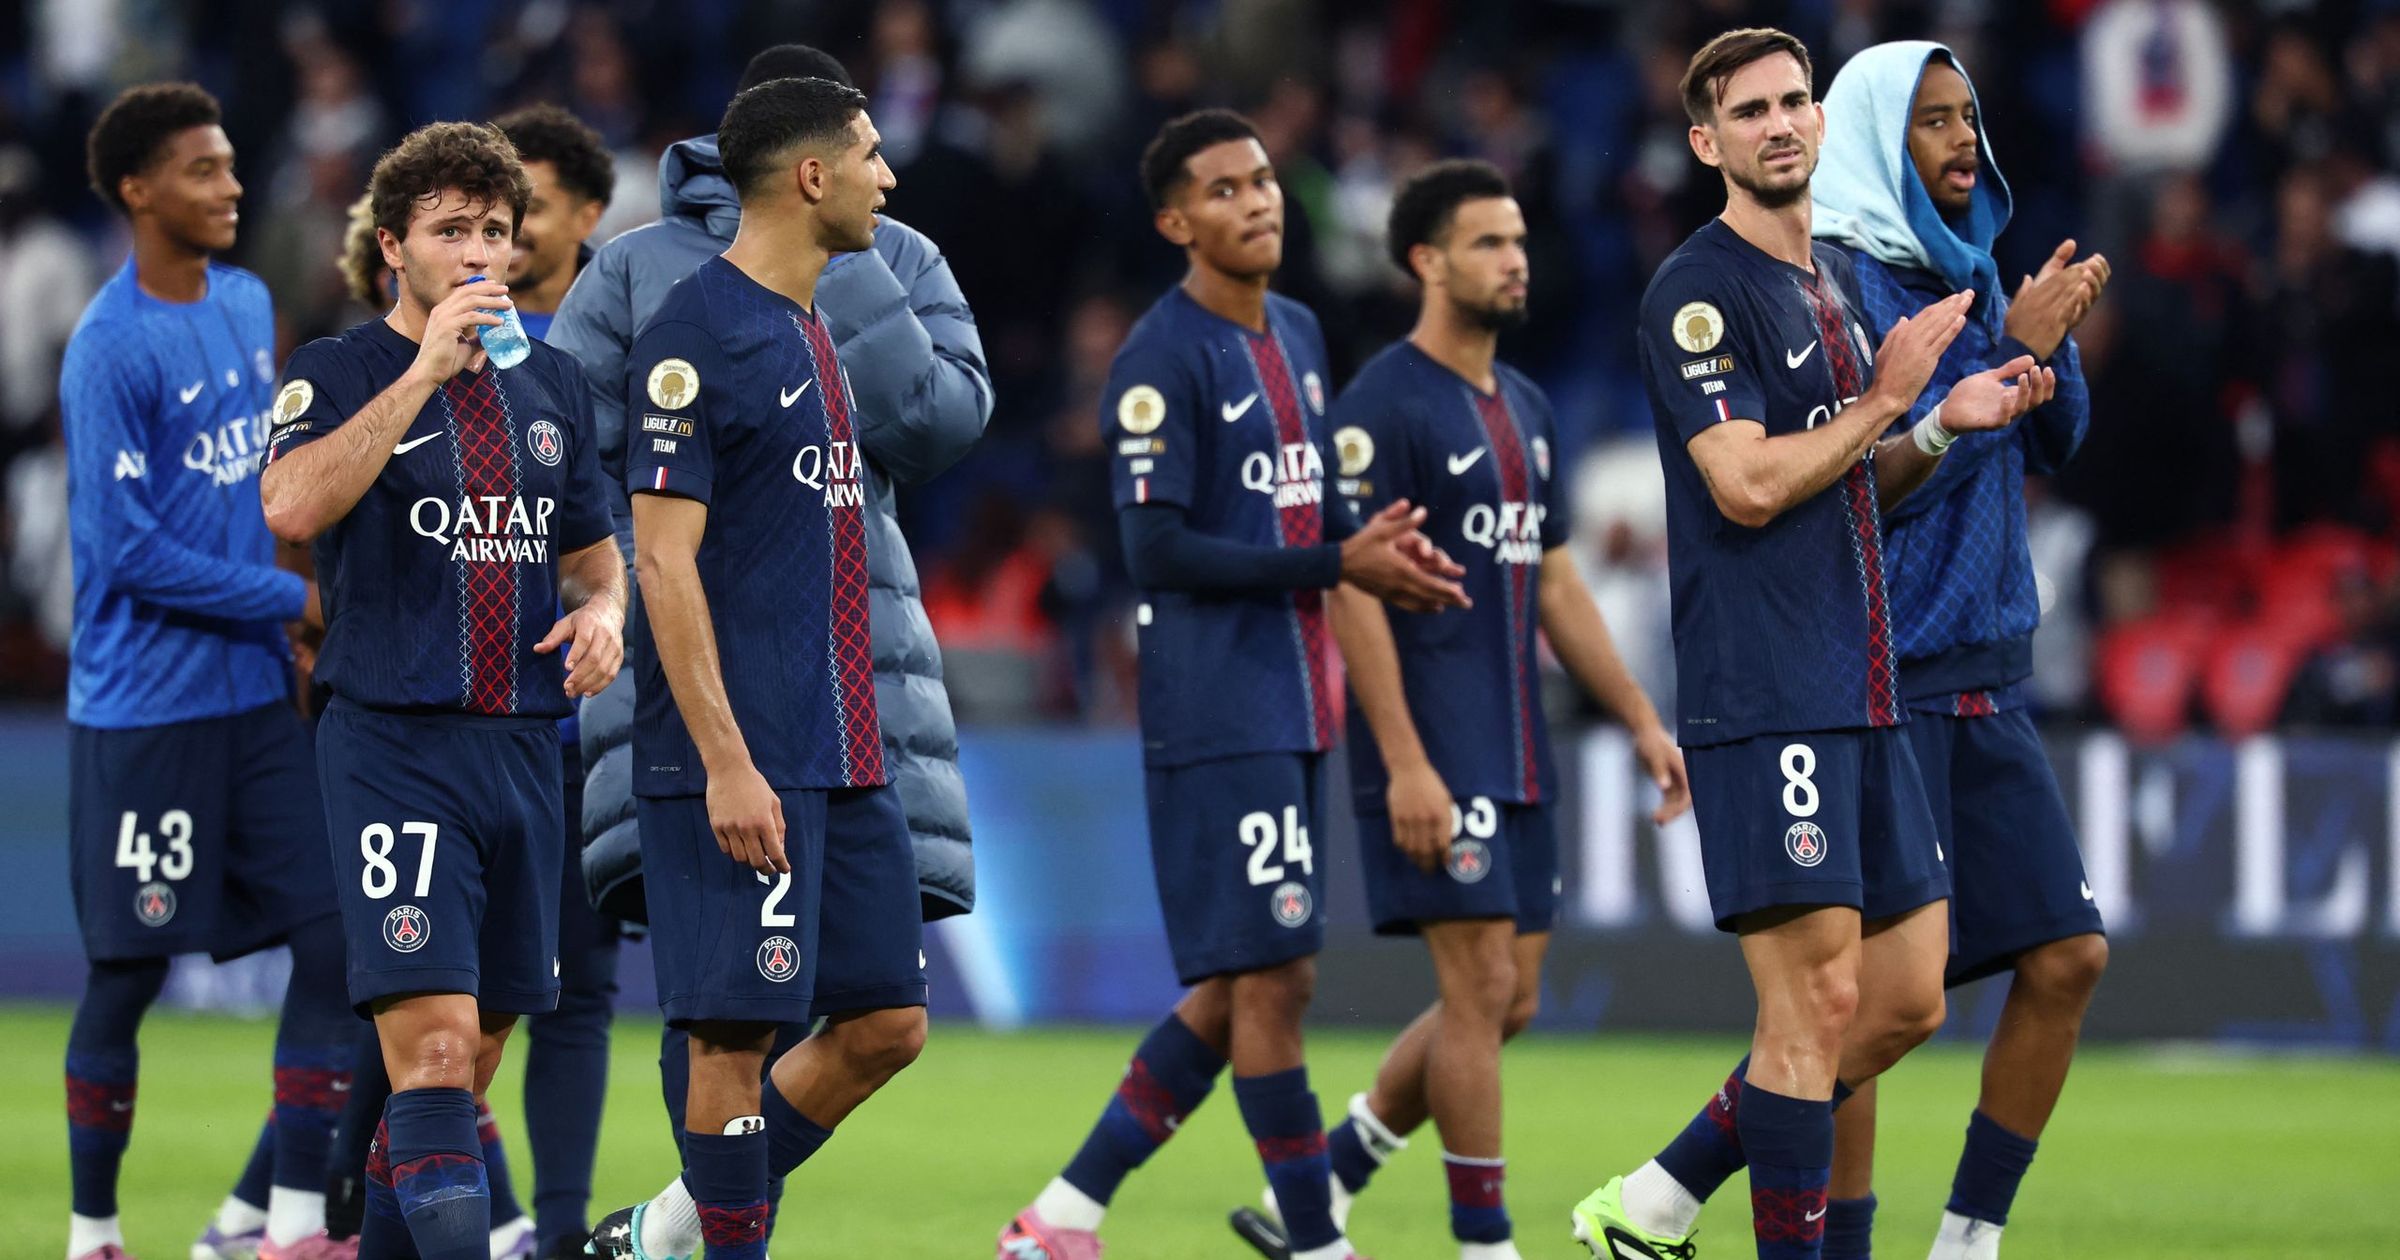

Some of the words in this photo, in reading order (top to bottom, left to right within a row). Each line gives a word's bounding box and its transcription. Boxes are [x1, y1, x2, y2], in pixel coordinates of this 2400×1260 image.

[1683, 362, 1710, 378] LIGUE
[644, 416, 668, 431] LIGUE
[793, 441, 863, 491] QATA
[1241, 440, 1324, 494] QATA
[823, 483, 865, 507] AIRW
[409, 495, 555, 546] QATAR
[450, 537, 548, 564] AIRWAY
[1780, 743, 1820, 817] 8
[115, 809, 194, 882] 43
[1239, 805, 1313, 886] 24
[1791, 824, 1818, 836] PARIS
[360, 821, 439, 899] 87
[390, 907, 421, 921] PARIS
[756, 860, 796, 927] 2
[764, 938, 792, 950] PARIS
